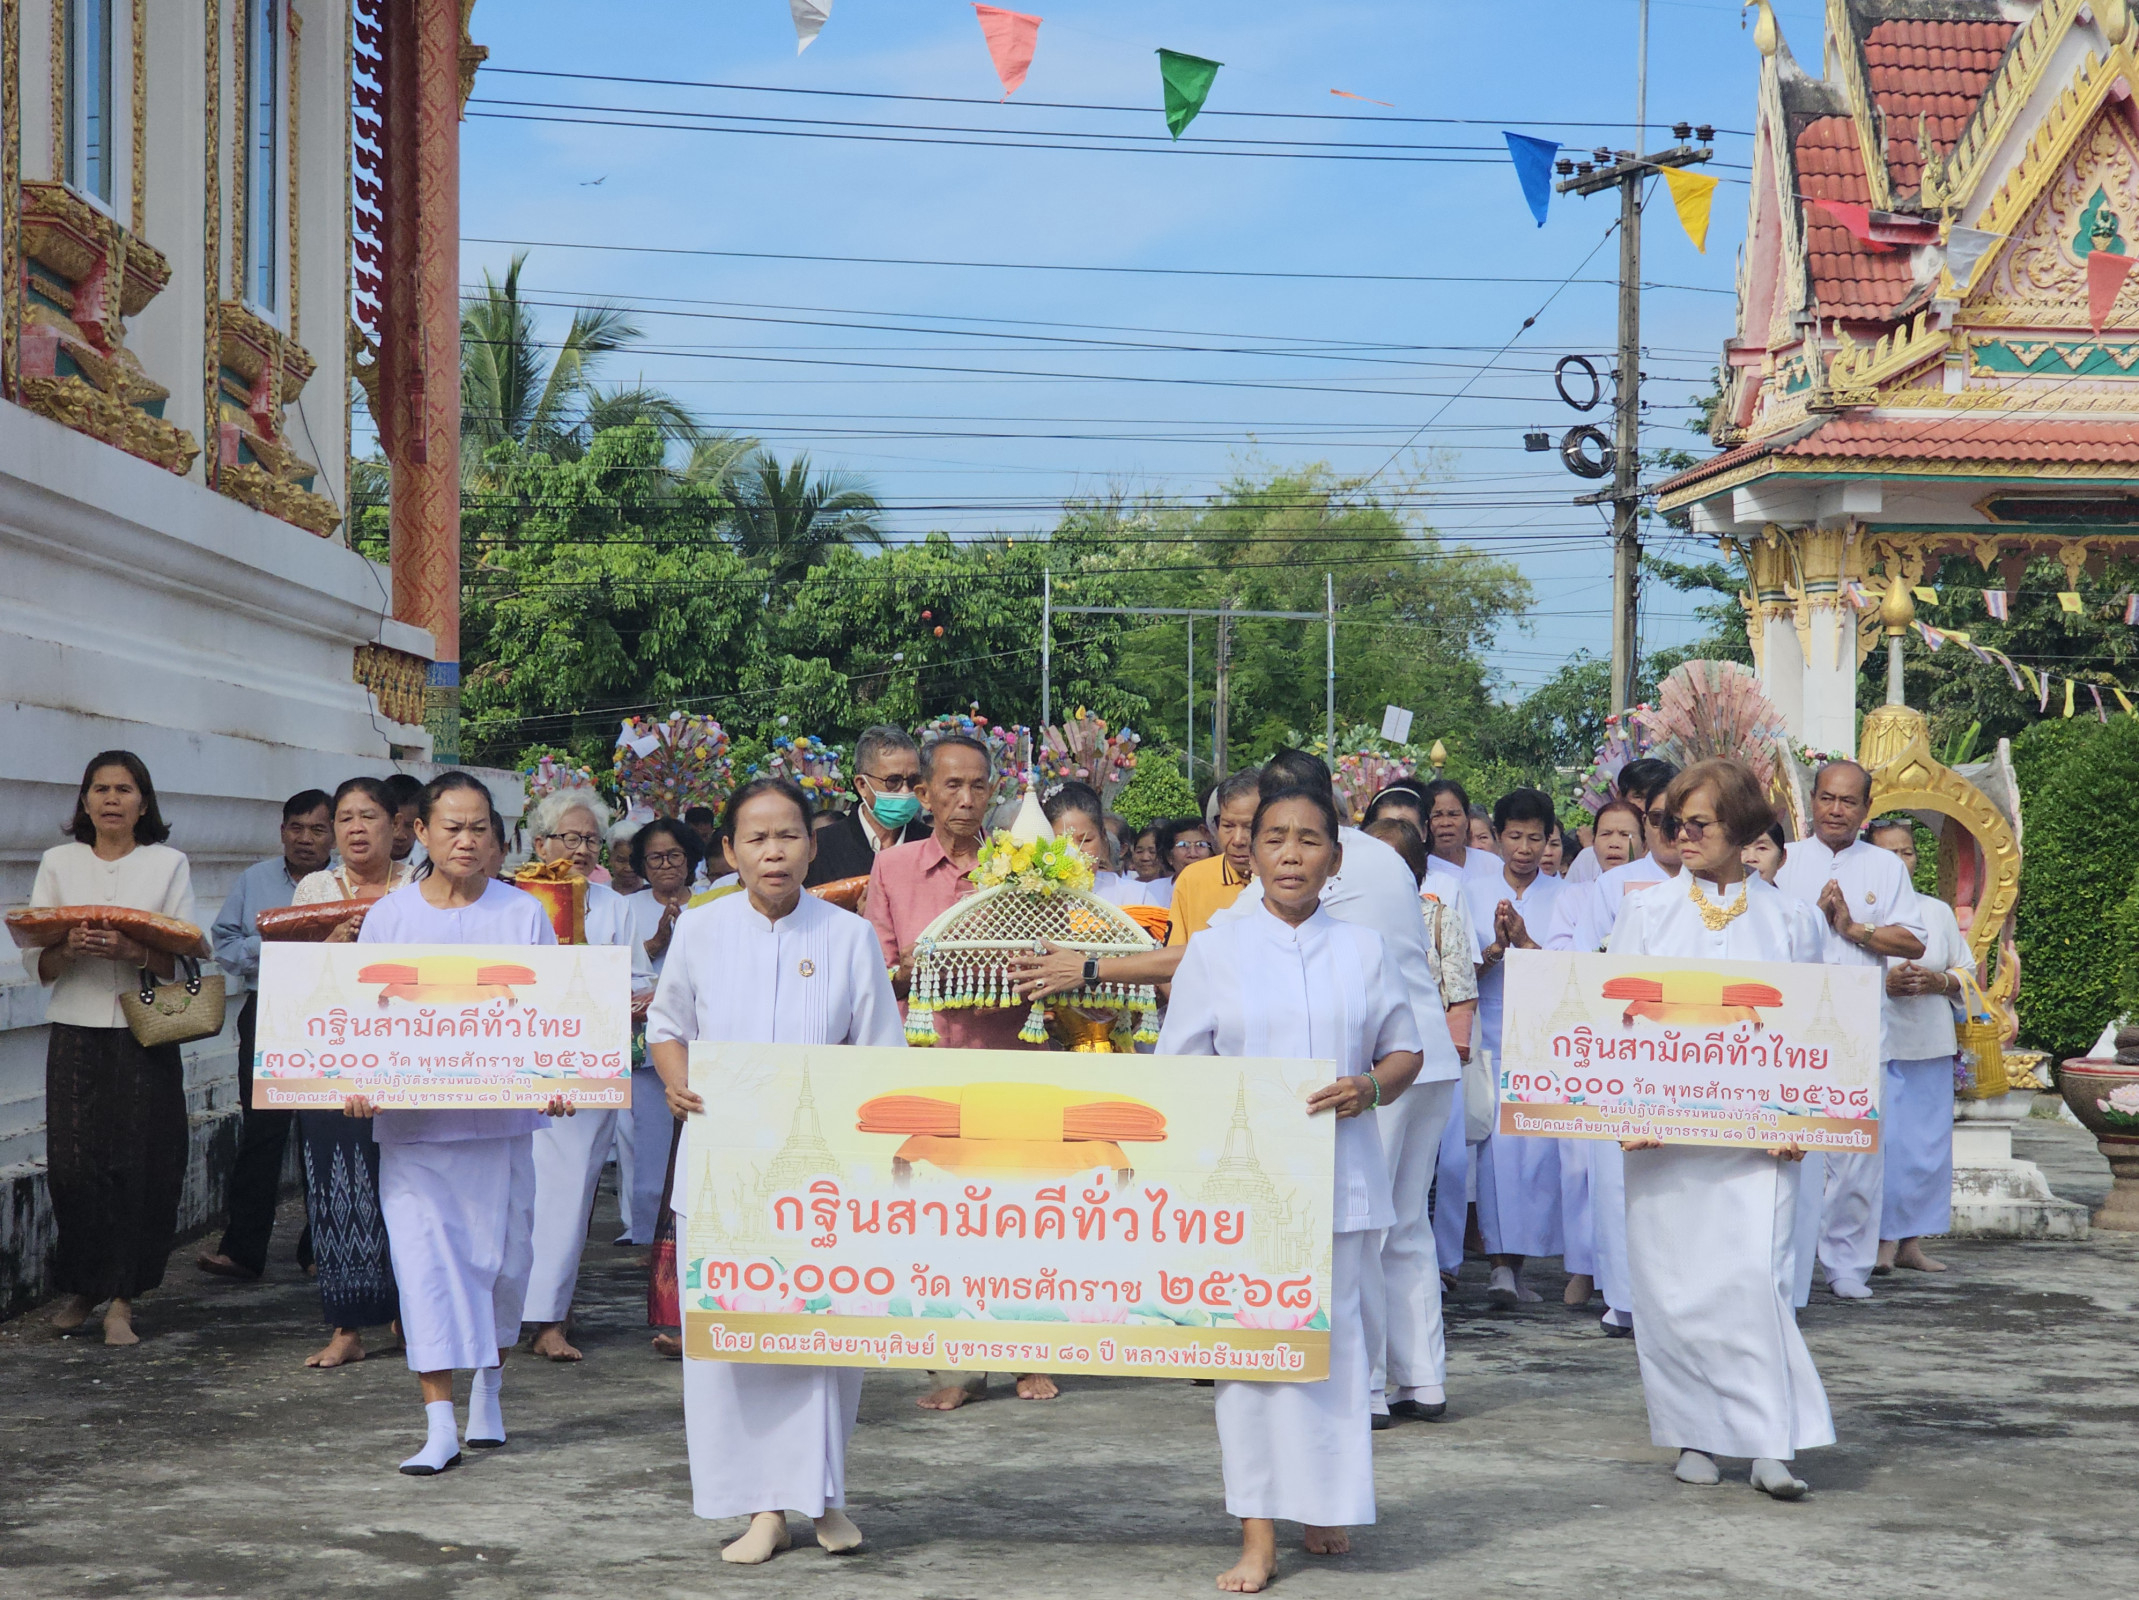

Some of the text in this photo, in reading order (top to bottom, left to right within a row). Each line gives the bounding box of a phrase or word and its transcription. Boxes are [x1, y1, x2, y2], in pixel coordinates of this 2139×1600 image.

[306, 1000, 582, 1046] กฐินสามัคคีทั่วไทย
[265, 1050, 622, 1074] ๓๐,๐๐๐ วัด พุทธศักราช ๒๕๖๘
[1552, 1024, 1830, 1069] กฐินสามัคคีทั่วไทย
[268, 1089, 296, 1103] โดย
[409, 1092, 474, 1106] บูชาธรรม
[478, 1093, 497, 1103] ๘๑
[502, 1088, 511, 1103] ปี
[1512, 1073, 1869, 1107] ๓๐,๐๐๐ วัด พุทธศักราช ๒๕๖๘
[1515, 1114, 1870, 1146] โดย คณะศิษยานุศิษย์ บูชาธรรม ๘๑ ปี หลวงพ่อธัมมชโย
[773, 1173, 1246, 1248] กฐินสามัคคีทั่วไทย
[707, 1259, 1313, 1312] ๓๐,๐๐๐ วัด พุทธศักราช ๒๕๖๘
[711, 1328, 1303, 1368] โดย คณะศิษยานุศิษย์ บูชาธรรม ๘๑ ปี หลวงพ่อธัมมชโย
